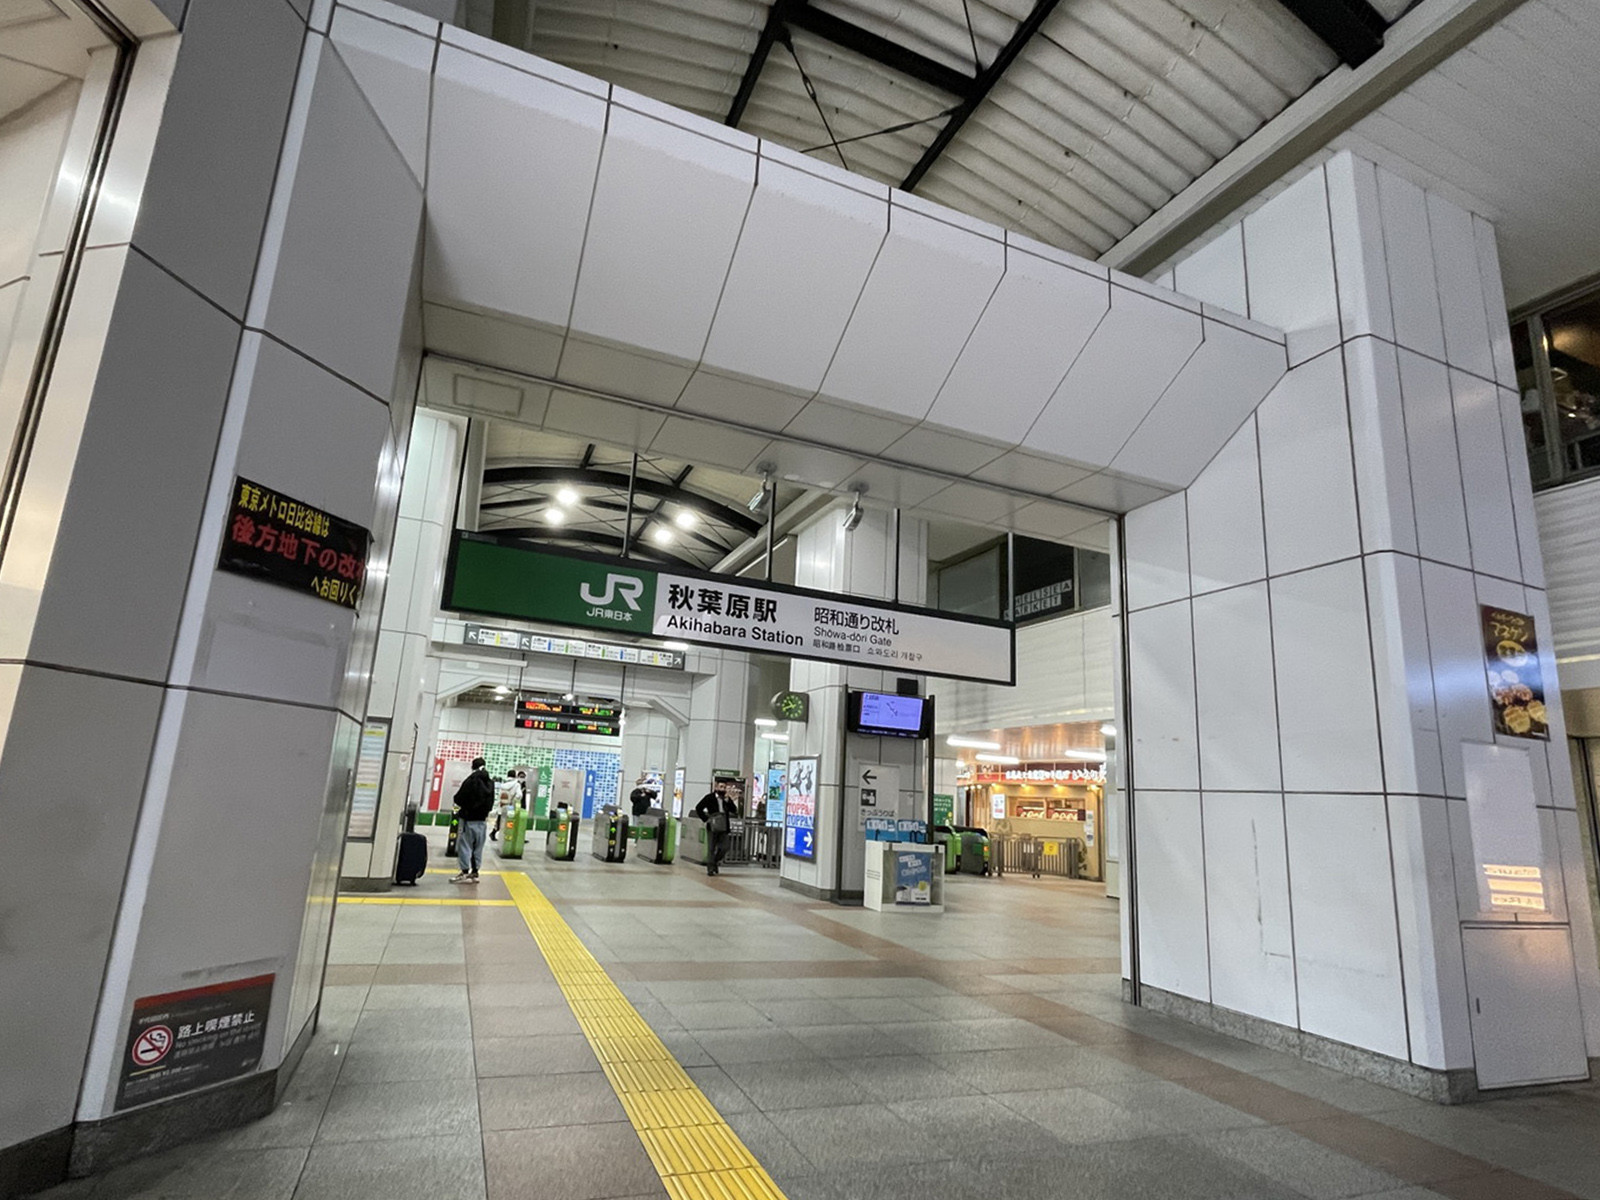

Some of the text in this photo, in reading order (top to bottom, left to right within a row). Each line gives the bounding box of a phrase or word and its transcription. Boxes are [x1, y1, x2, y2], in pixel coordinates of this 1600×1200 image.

[238, 483, 330, 538] 東京メトロ日比谷線は
[580, 573, 644, 611] JR
[668, 584, 777, 623] 秋葉原駅
[586, 607, 633, 622] JR東日本
[814, 607, 899, 635] 昭和通り改札
[667, 615, 803, 646] Akihabara Station
[869, 635, 892, 647] Gate
[177, 1010, 255, 1039] 路上喫煙禁止
